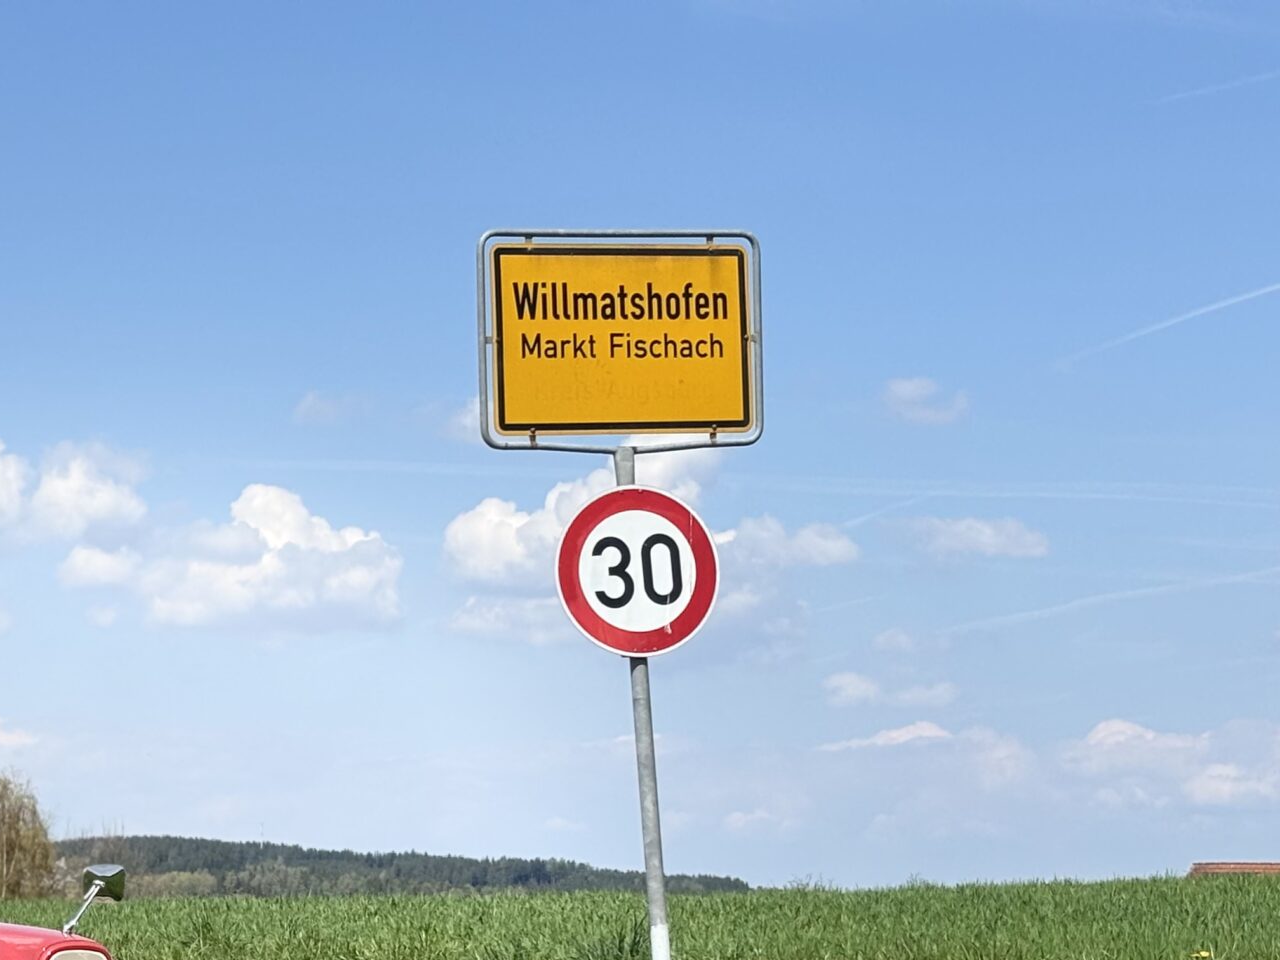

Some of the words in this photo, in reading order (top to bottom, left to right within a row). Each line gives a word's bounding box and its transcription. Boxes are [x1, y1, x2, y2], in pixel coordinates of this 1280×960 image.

[512, 282, 728, 320] Willmatshofen
[521, 333, 597, 359] Markt
[609, 333, 724, 358] Fischach
[591, 533, 683, 609] 30
